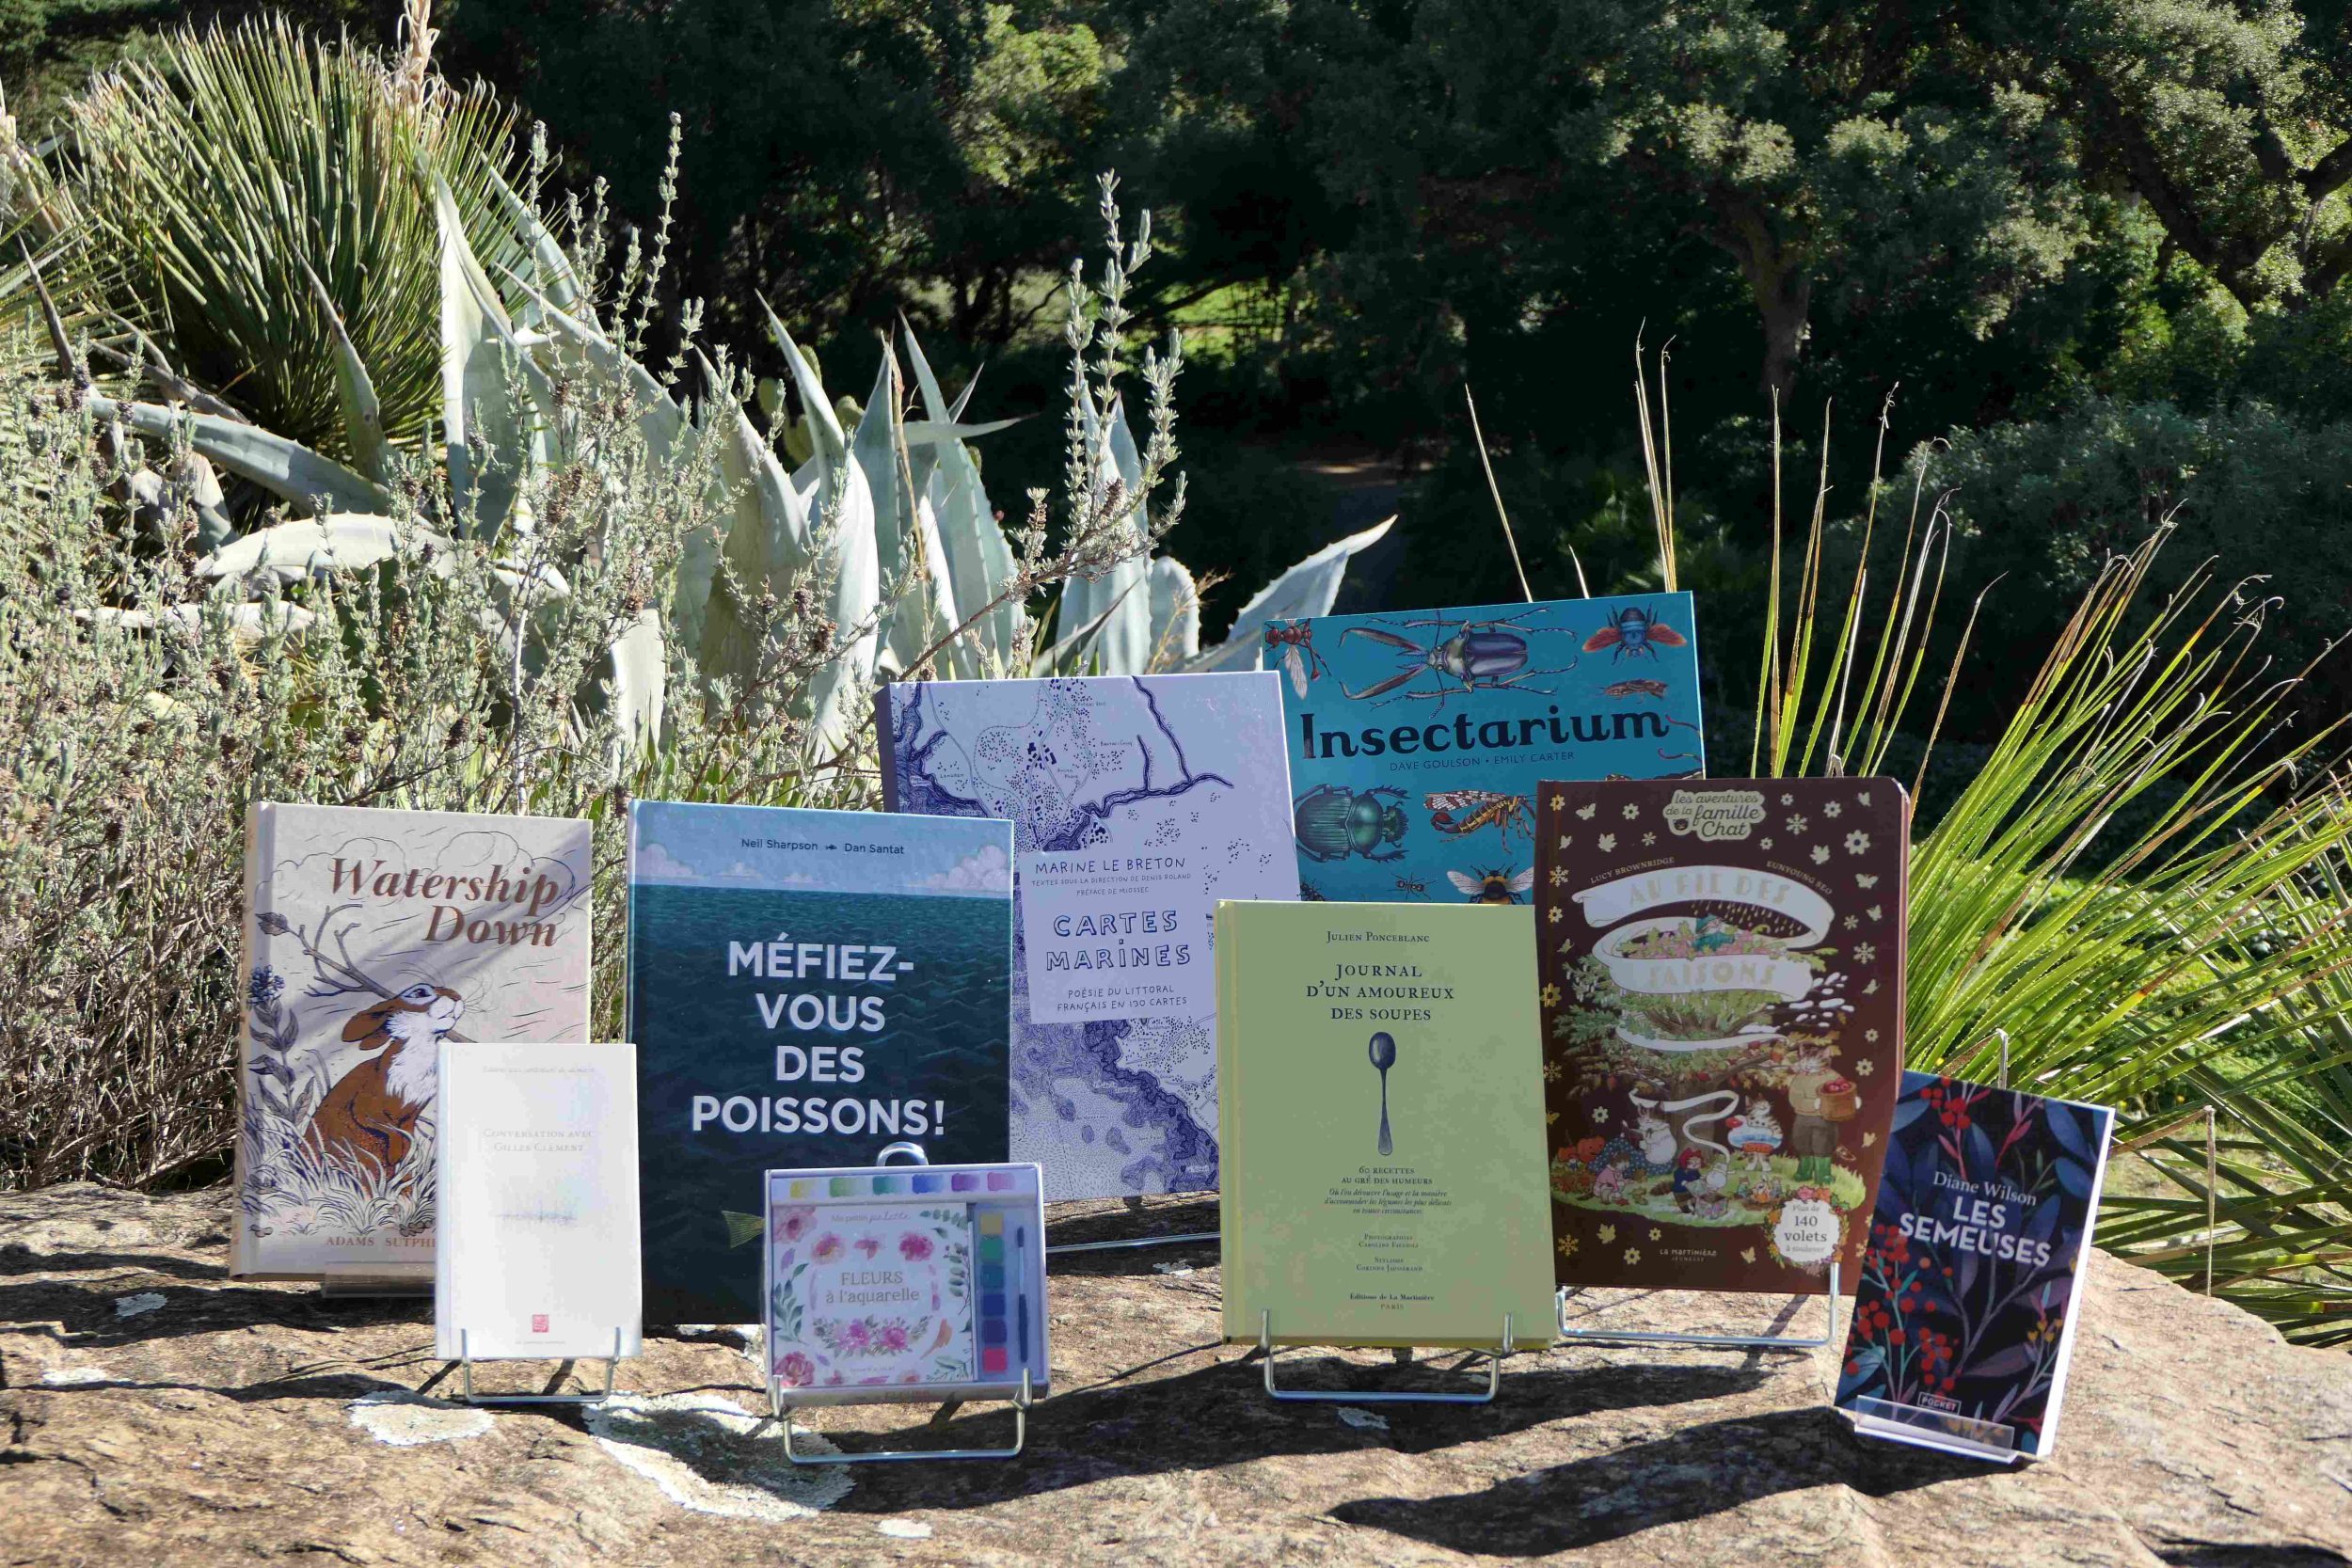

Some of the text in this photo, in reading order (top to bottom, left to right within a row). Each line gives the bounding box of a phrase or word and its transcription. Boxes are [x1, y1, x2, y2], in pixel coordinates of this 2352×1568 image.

[1301, 705, 1670, 759] Insectarium
[1390, 752, 1574, 771] DAVE GOULSON EMILY CARTER
[1675, 793, 1758, 804] les aventures
[1665, 805, 1692, 815] de la
[1693, 804, 1761, 826] famille
[1702, 820, 1747, 837] Chat
[741, 838, 905, 855] Neil Sharpson Dan Santat
[1035, 857, 1185, 874] MARINE LE BRETON
[1589, 856, 1675, 884] LUCY BROWNRIDGE
[332, 857, 560, 917] Watership
[1031, 879, 1059, 887] TEXTES
[1076, 887, 1105, 896] PRÉFACE
[1629, 878, 1662, 905] AU
[1736, 876, 1791, 904] DES
[422, 904, 560, 947] Down
[1053, 911, 1177, 937] CARTES
[1327, 931, 1430, 943] JULIEN PONCEBLANC
[727, 931, 914, 981] MÉFIEZ-
[1335, 964, 1422, 980] JOURNAL
[1649, 961, 1776, 986] SAISONS
[1068, 985, 1175, 999] POÉSIE DU LITTORAL
[1306, 980, 1454, 999] D'UN AMOUREUX
[755, 993, 886, 1032] VOUS
[1057, 1001, 1107, 1013] FRANÇAIS
[1111, 1000, 1125, 1009] EN
[1150, 996, 1187, 1006] CARTES
[1330, 1007, 1431, 1021] DES SOUPES
[776, 1045, 866, 1084] DES
[692, 1095, 946, 1135] POISSONS!
[1359, 1165, 1371, 1175] 60
[1355, 1175, 1371, 1184] GRÉ
[1932, 1170, 2038, 1207] Diane Wilson
[1952, 1195, 2008, 1229] LES
[1795, 1215, 1819, 1227] 140
[326, 1236, 436, 1247] ADAMS SUTPHI
[1784, 1229, 1828, 1242] volets
[1899, 1212, 2052, 1268] SEMEUSES
[841, 1271, 903, 1286] FLEURS
[826, 1287, 920, 1306] à l'aquarelle
[1921, 1396, 1957, 1412] POCKET
